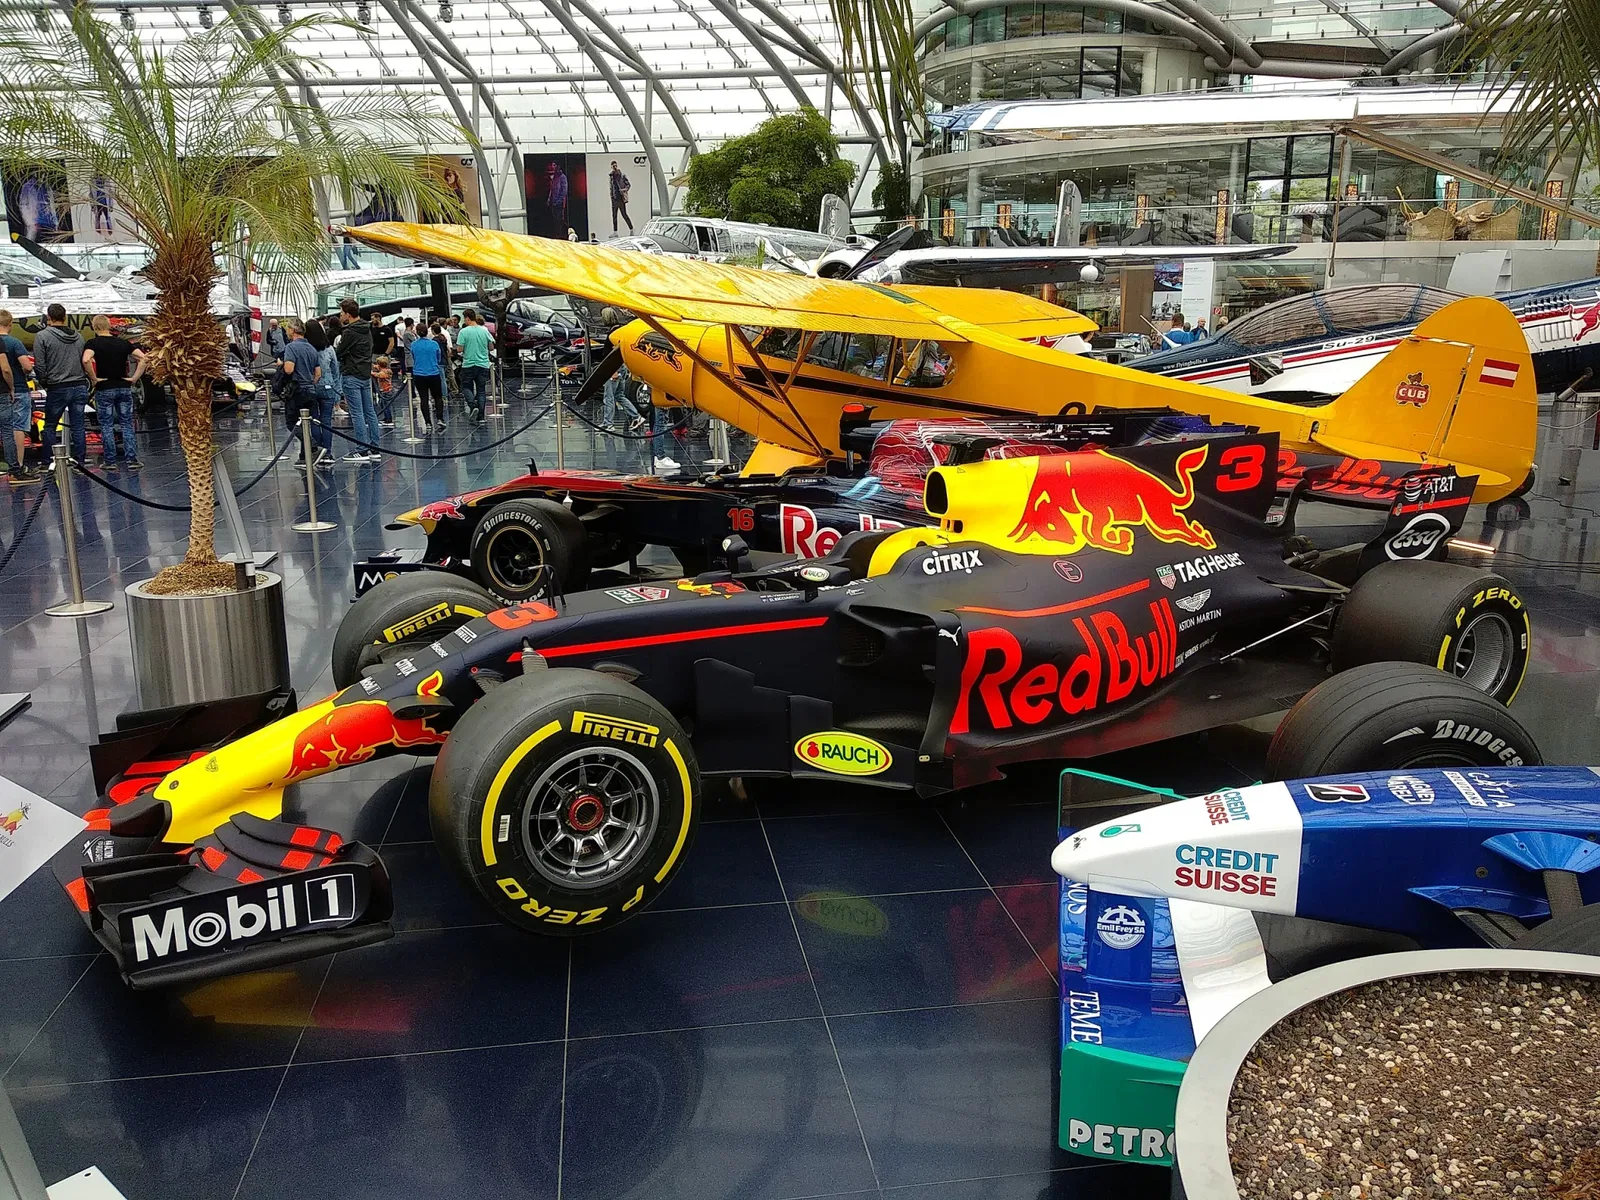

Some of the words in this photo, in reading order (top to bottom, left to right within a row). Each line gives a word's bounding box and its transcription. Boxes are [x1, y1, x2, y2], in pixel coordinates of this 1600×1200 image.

[1323, 335, 1375, 350] Su-29
[1398, 387, 1427, 399] CUB
[1216, 444, 1266, 492] 3
[1424, 475, 1456, 494] AT&T
[482, 511, 542, 534] BRIDGESTONE
[727, 508, 755, 531] 16
[780, 504, 873, 560] Re
[807, 570, 826, 578] RAUCH
[1157, 566, 1173, 578] TAG
[487, 601, 558, 630] 3
[1178, 617, 1195, 633] ASTON
[1196, 608, 1222, 625] MARTIN
[1455, 607, 1466, 629] P
[1472, 587, 1522, 610] ZERO
[383, 602, 452, 644] PIRELLI
[454, 624, 478, 644] PIRELLI
[949, 617, 1101, 735] Red
[1090, 597, 1177, 704] Bull
[571, 711, 660, 748] PIRELLI
[821, 743, 879, 765] RAUCH
[1204, 794, 1229, 826] SUISSE
[1223, 791, 1250, 821] CREDIT
[1175, 843, 1279, 873] CREDIT
[1174, 866, 1277, 897] SUISSE
[496, 877, 608, 925] ZERO
[622, 884, 645, 912] P
[132, 884, 297, 962] Mobil
[1096, 923, 1115, 933] Emil
[1115, 924, 1134, 934] Frey
[1134, 925, 1145, 934] SA
[1069, 990, 1103, 1045] TEME
